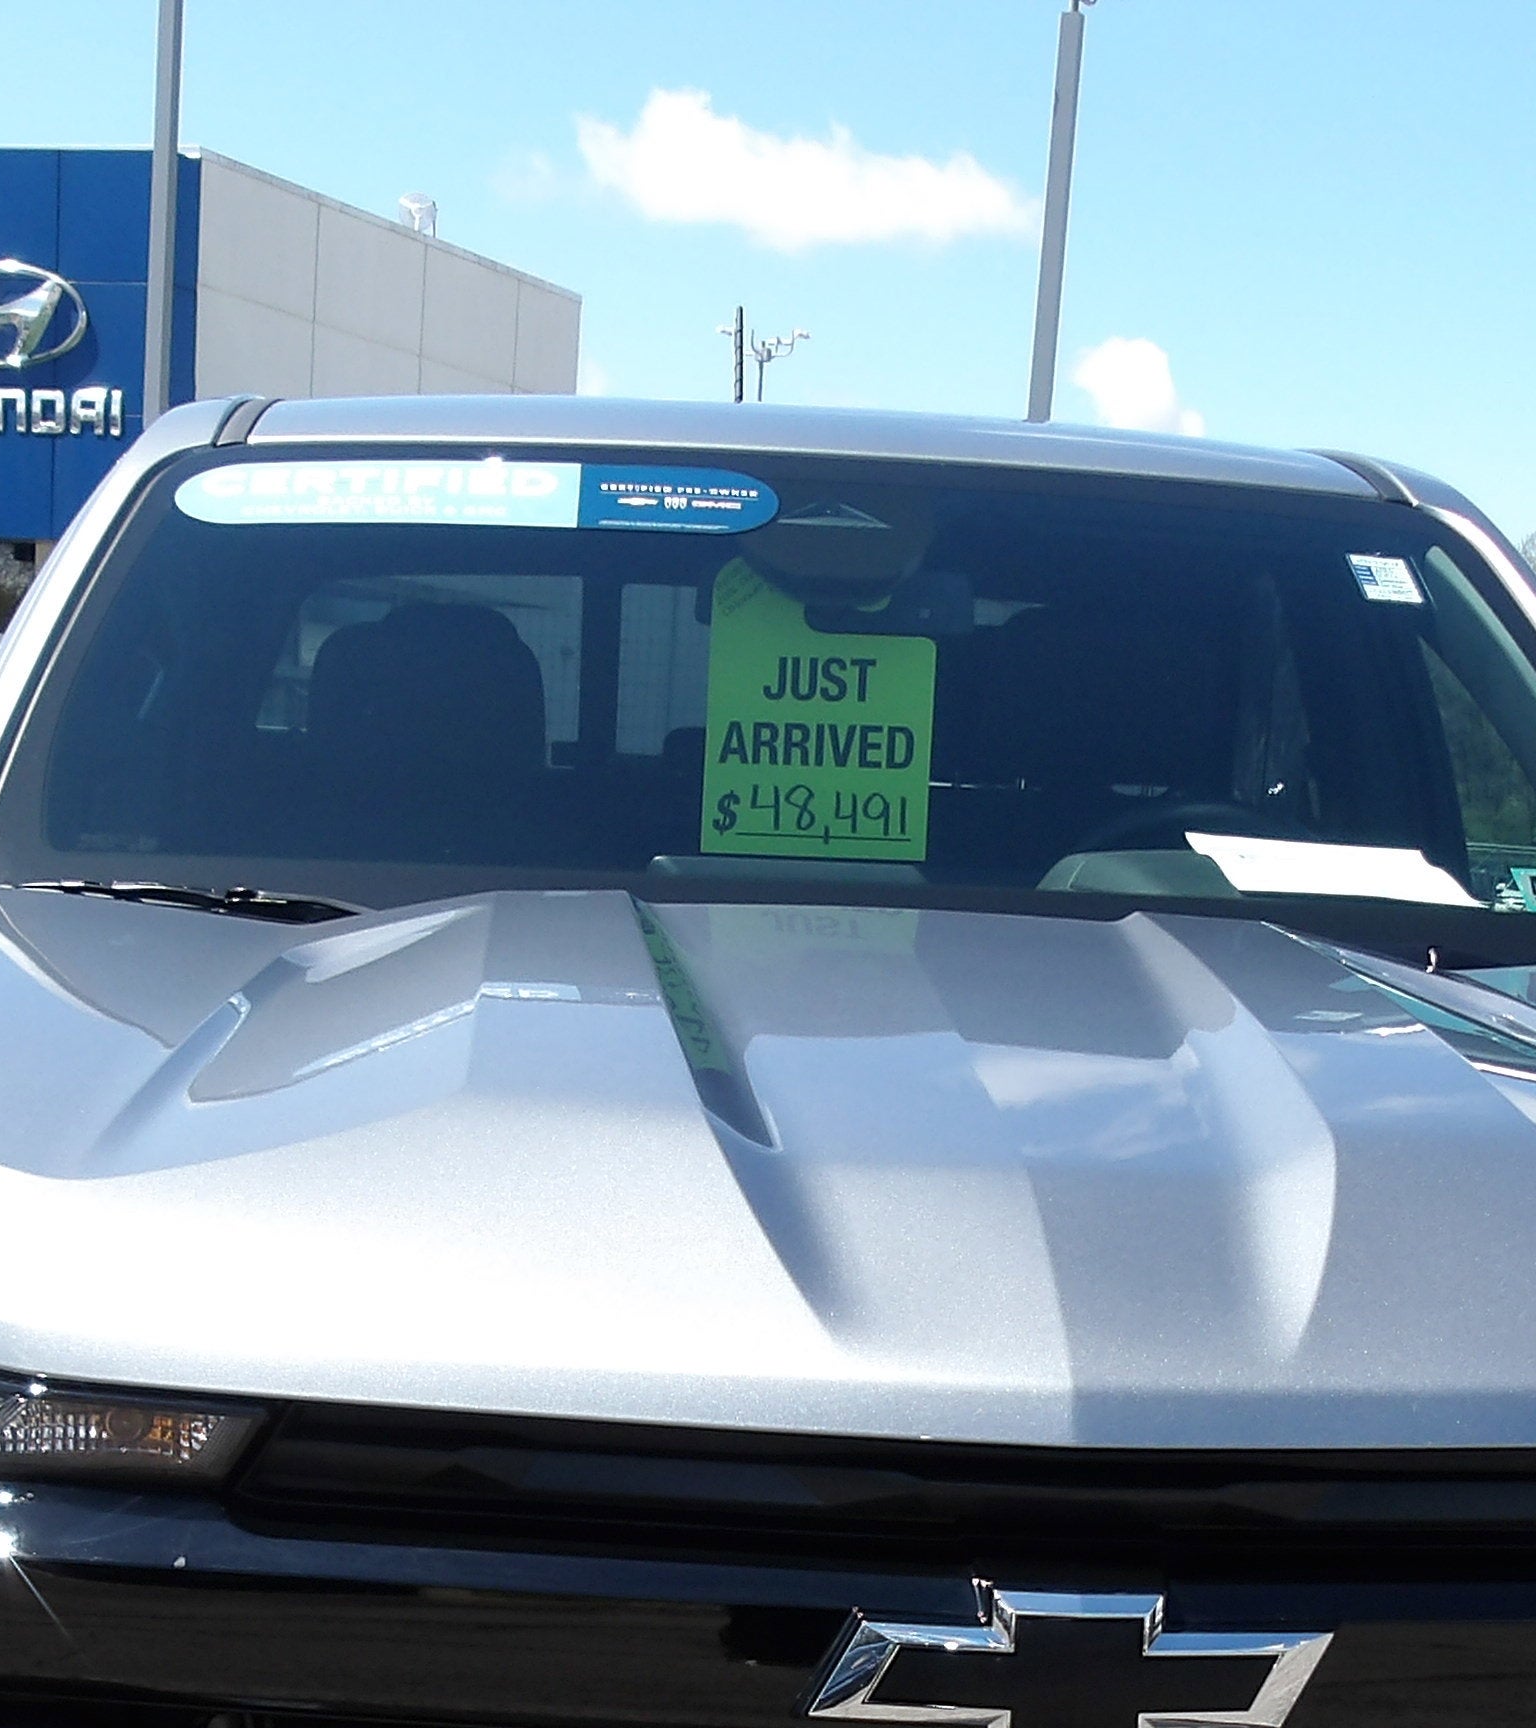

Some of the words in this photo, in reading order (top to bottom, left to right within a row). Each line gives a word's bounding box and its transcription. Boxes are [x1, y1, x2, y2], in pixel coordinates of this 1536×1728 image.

[201, 465, 558, 497] CERTIFIED
[763, 656, 877, 702] JUST
[718, 720, 915, 770] ARRIVED
